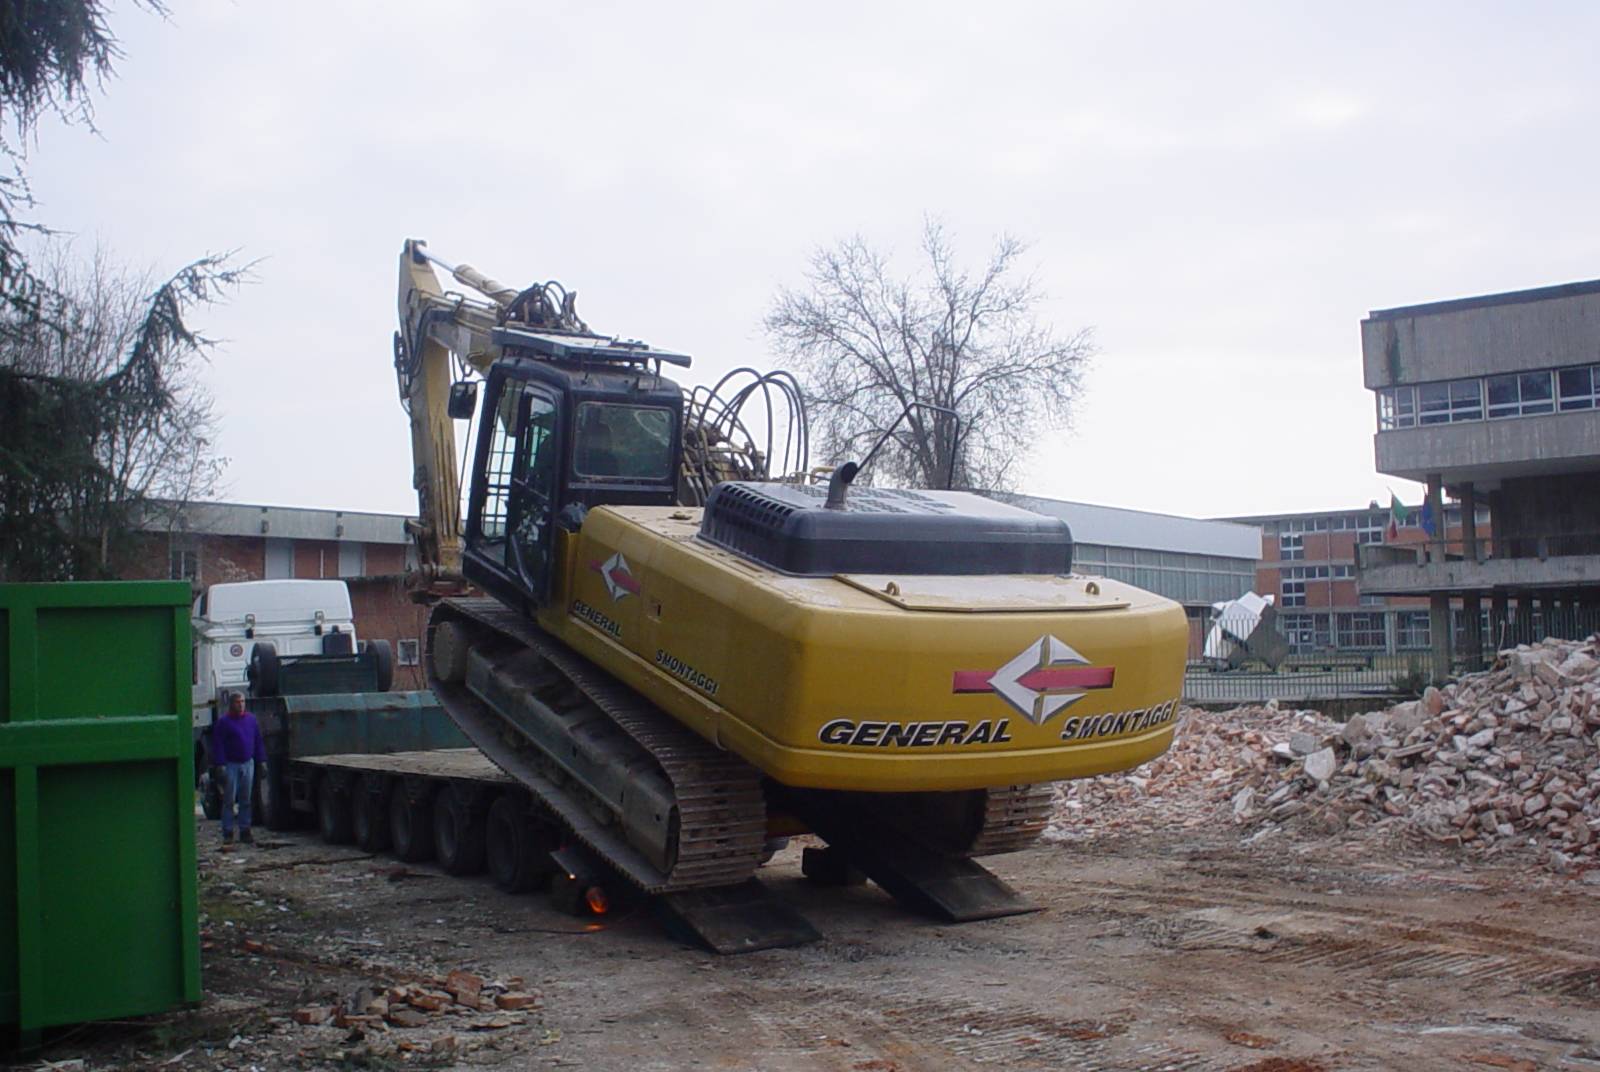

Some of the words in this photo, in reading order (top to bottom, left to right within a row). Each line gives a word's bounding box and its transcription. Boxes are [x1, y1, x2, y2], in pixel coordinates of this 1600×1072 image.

[573, 601, 621, 637] GENERAL
[656, 650, 718, 695] SMONTAGGI
[819, 718, 1012, 748] GENERAL
[1061, 698, 1178, 740] SMONTAGGI
